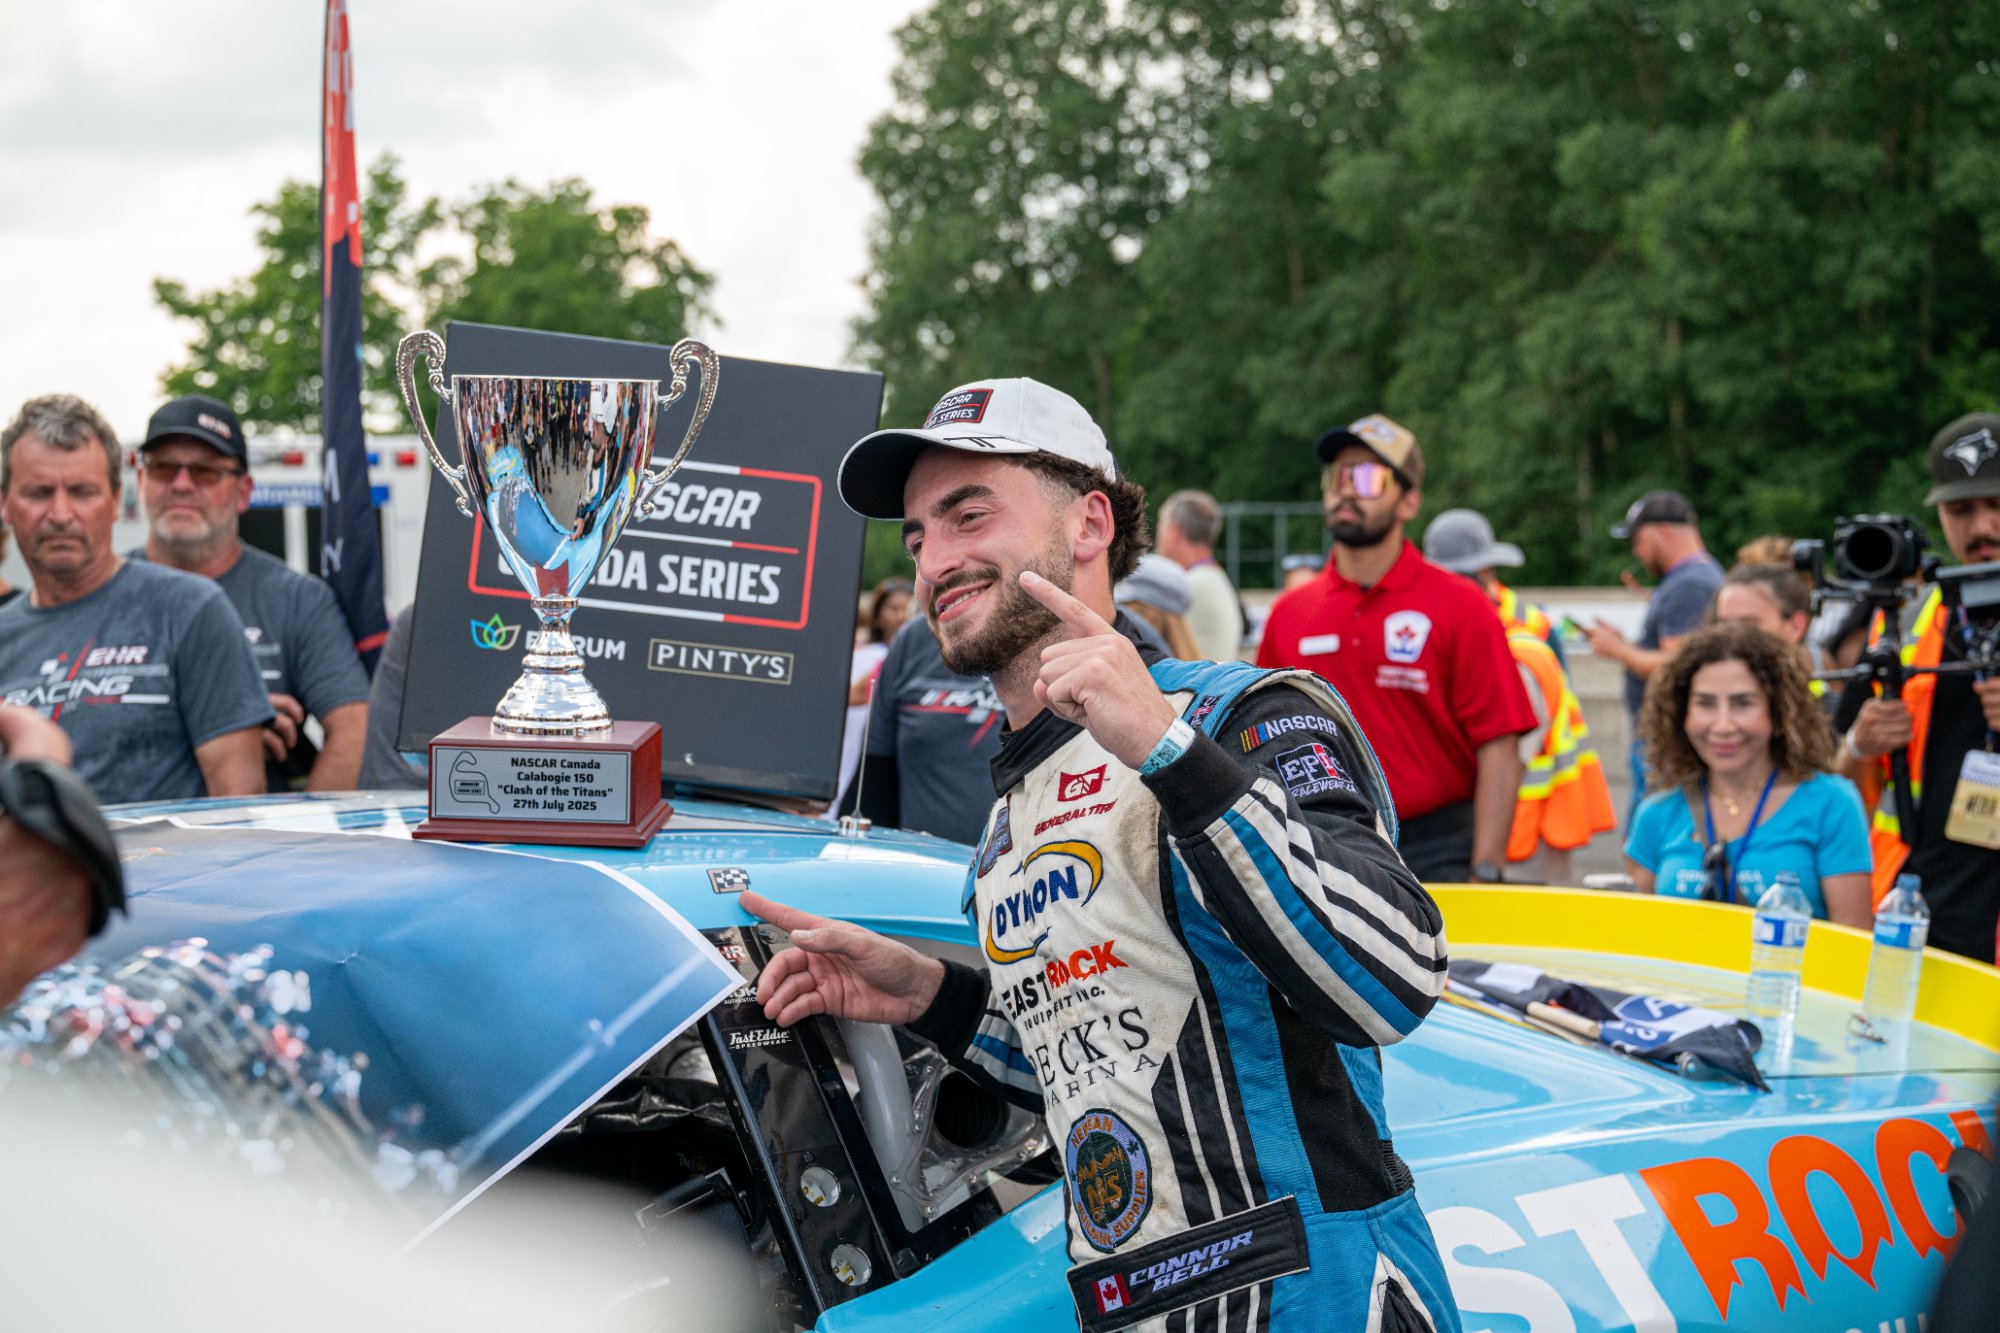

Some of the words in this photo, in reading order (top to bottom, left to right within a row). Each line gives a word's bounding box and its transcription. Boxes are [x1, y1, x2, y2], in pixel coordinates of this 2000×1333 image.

[938, 408, 976, 423] SERIES
[633, 481, 762, 530] SCAR
[656, 553, 781, 605] SERIES
[86, 645, 148, 667] EHR
[525, 630, 626, 661] ERUM
[657, 643, 785, 679] PINTY'S
[2, 675, 134, 707] RACING
[1265, 715, 1338, 739] NASCAR
[510, 757, 557, 769] NASCAR
[560, 759, 601, 770] Canada
[517, 771, 571, 784] Calabogie
[573, 773, 594, 783] 150
[497, 784, 533, 796] "Clash
[535, 786, 548, 796] of
[551, 787, 570, 797] the
[572, 787, 613, 798] Titans"
[513, 799, 539, 810] 27th
[542, 800, 565, 813] July
[567, 801, 597, 812] 2025
[1034, 808, 1087, 836] GENERAL
[1029, 1006, 1150, 1087] ECK'S
[1046, 1053, 1161, 1111] ARINA
[1129, 1230, 1254, 1287] CONNOR
[1152, 1255, 1230, 1293] BELL
